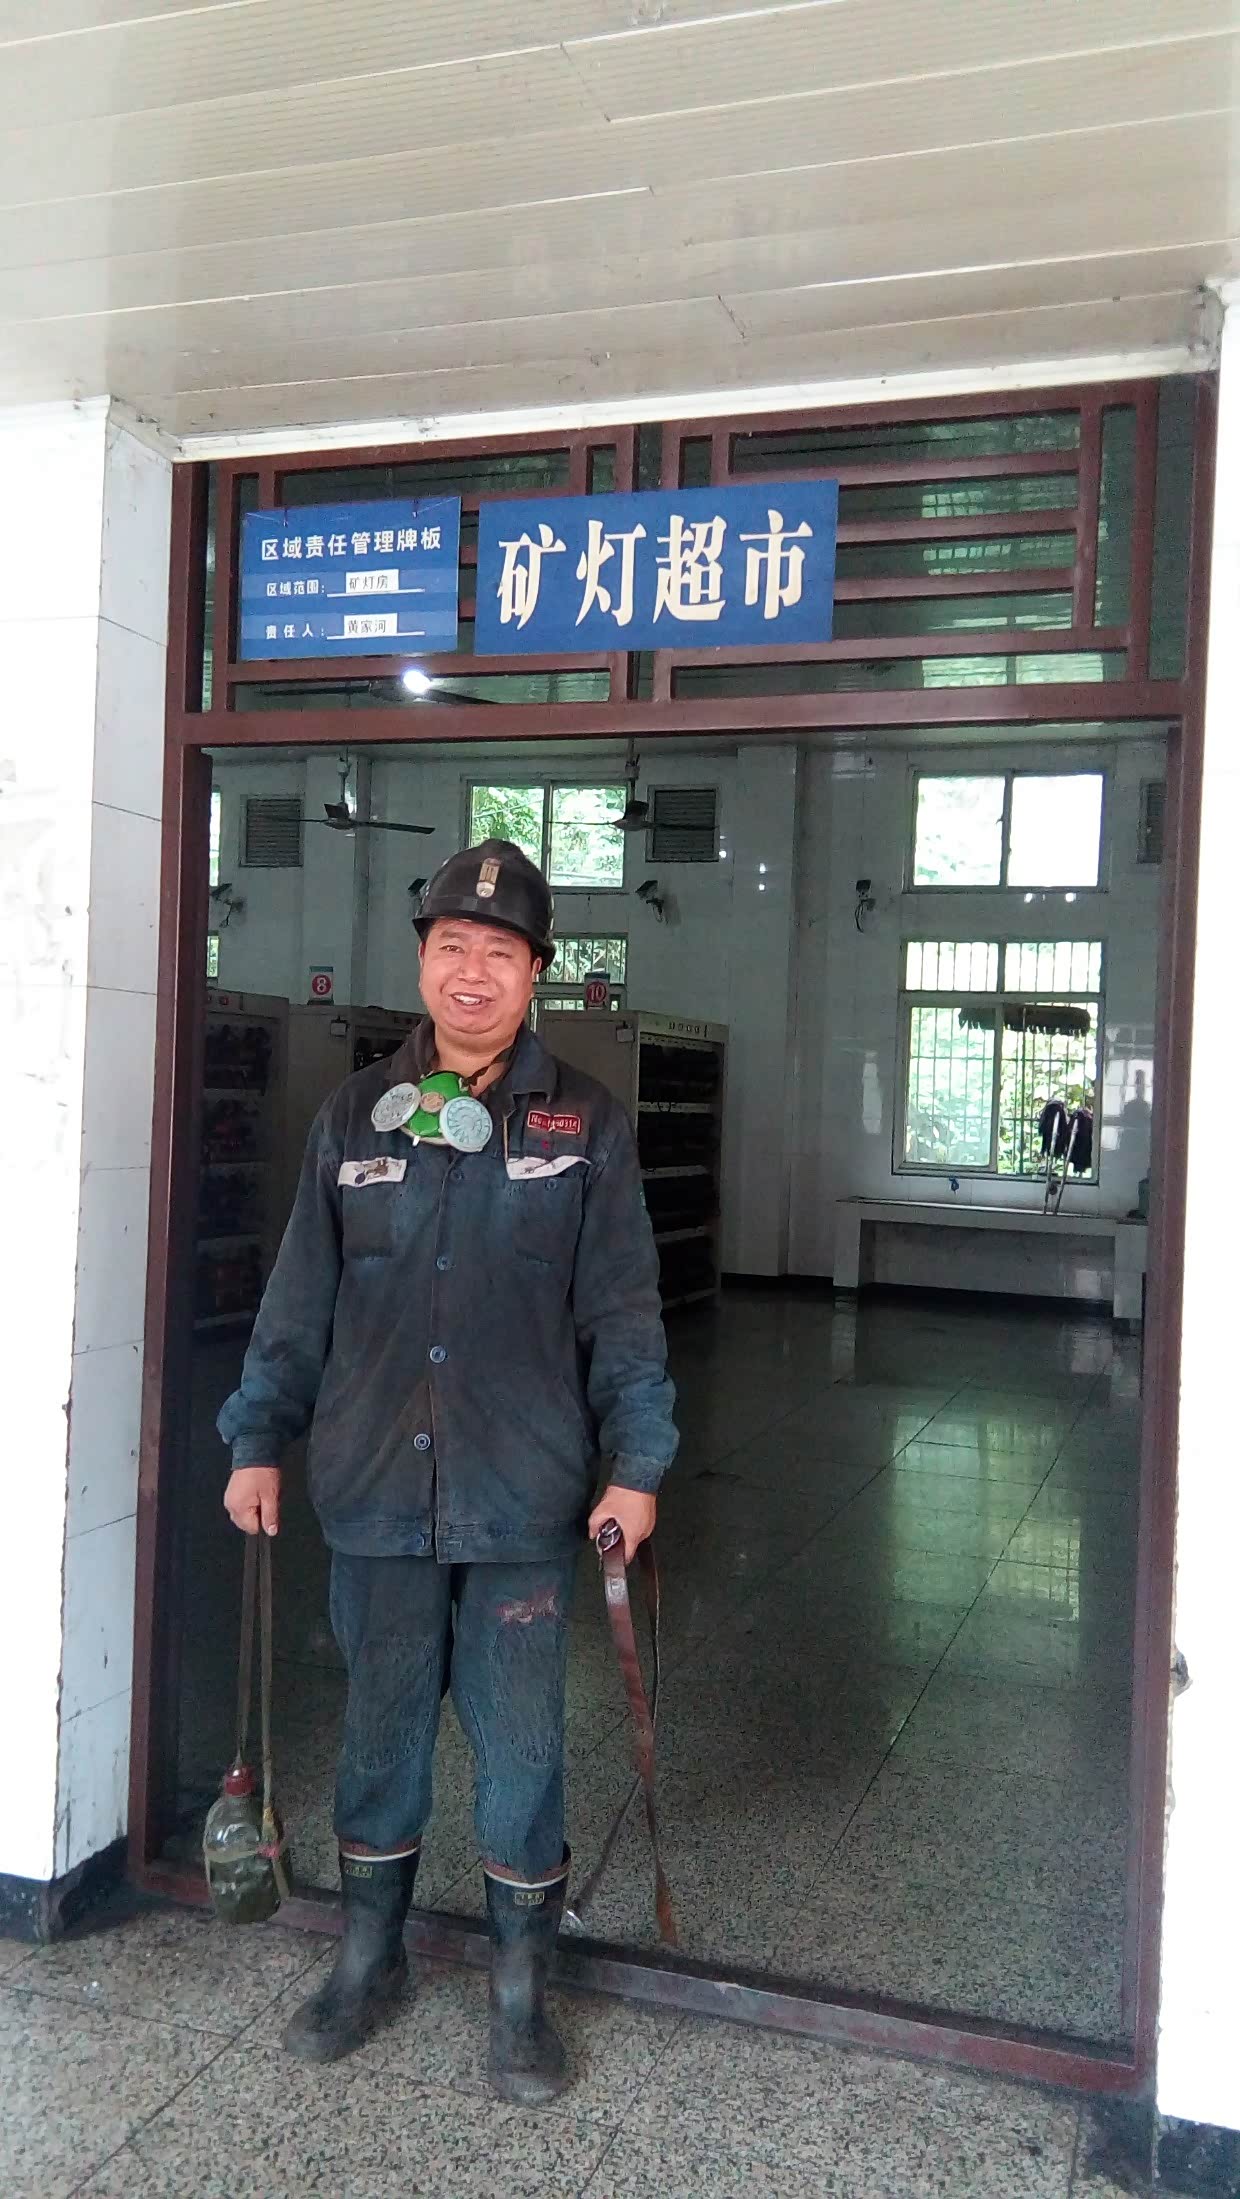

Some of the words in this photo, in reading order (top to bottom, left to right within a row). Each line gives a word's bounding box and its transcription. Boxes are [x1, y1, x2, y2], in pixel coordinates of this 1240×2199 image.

[261, 526, 441, 561] 区域责任管理牌板
[497, 509, 813, 630] 矿灯超市
[349, 574, 389, 591] 矿灯房
[347, 619, 387, 634] 黄家河
[316, 977, 327, 993] 8
[589, 985, 606, 1001] 10
